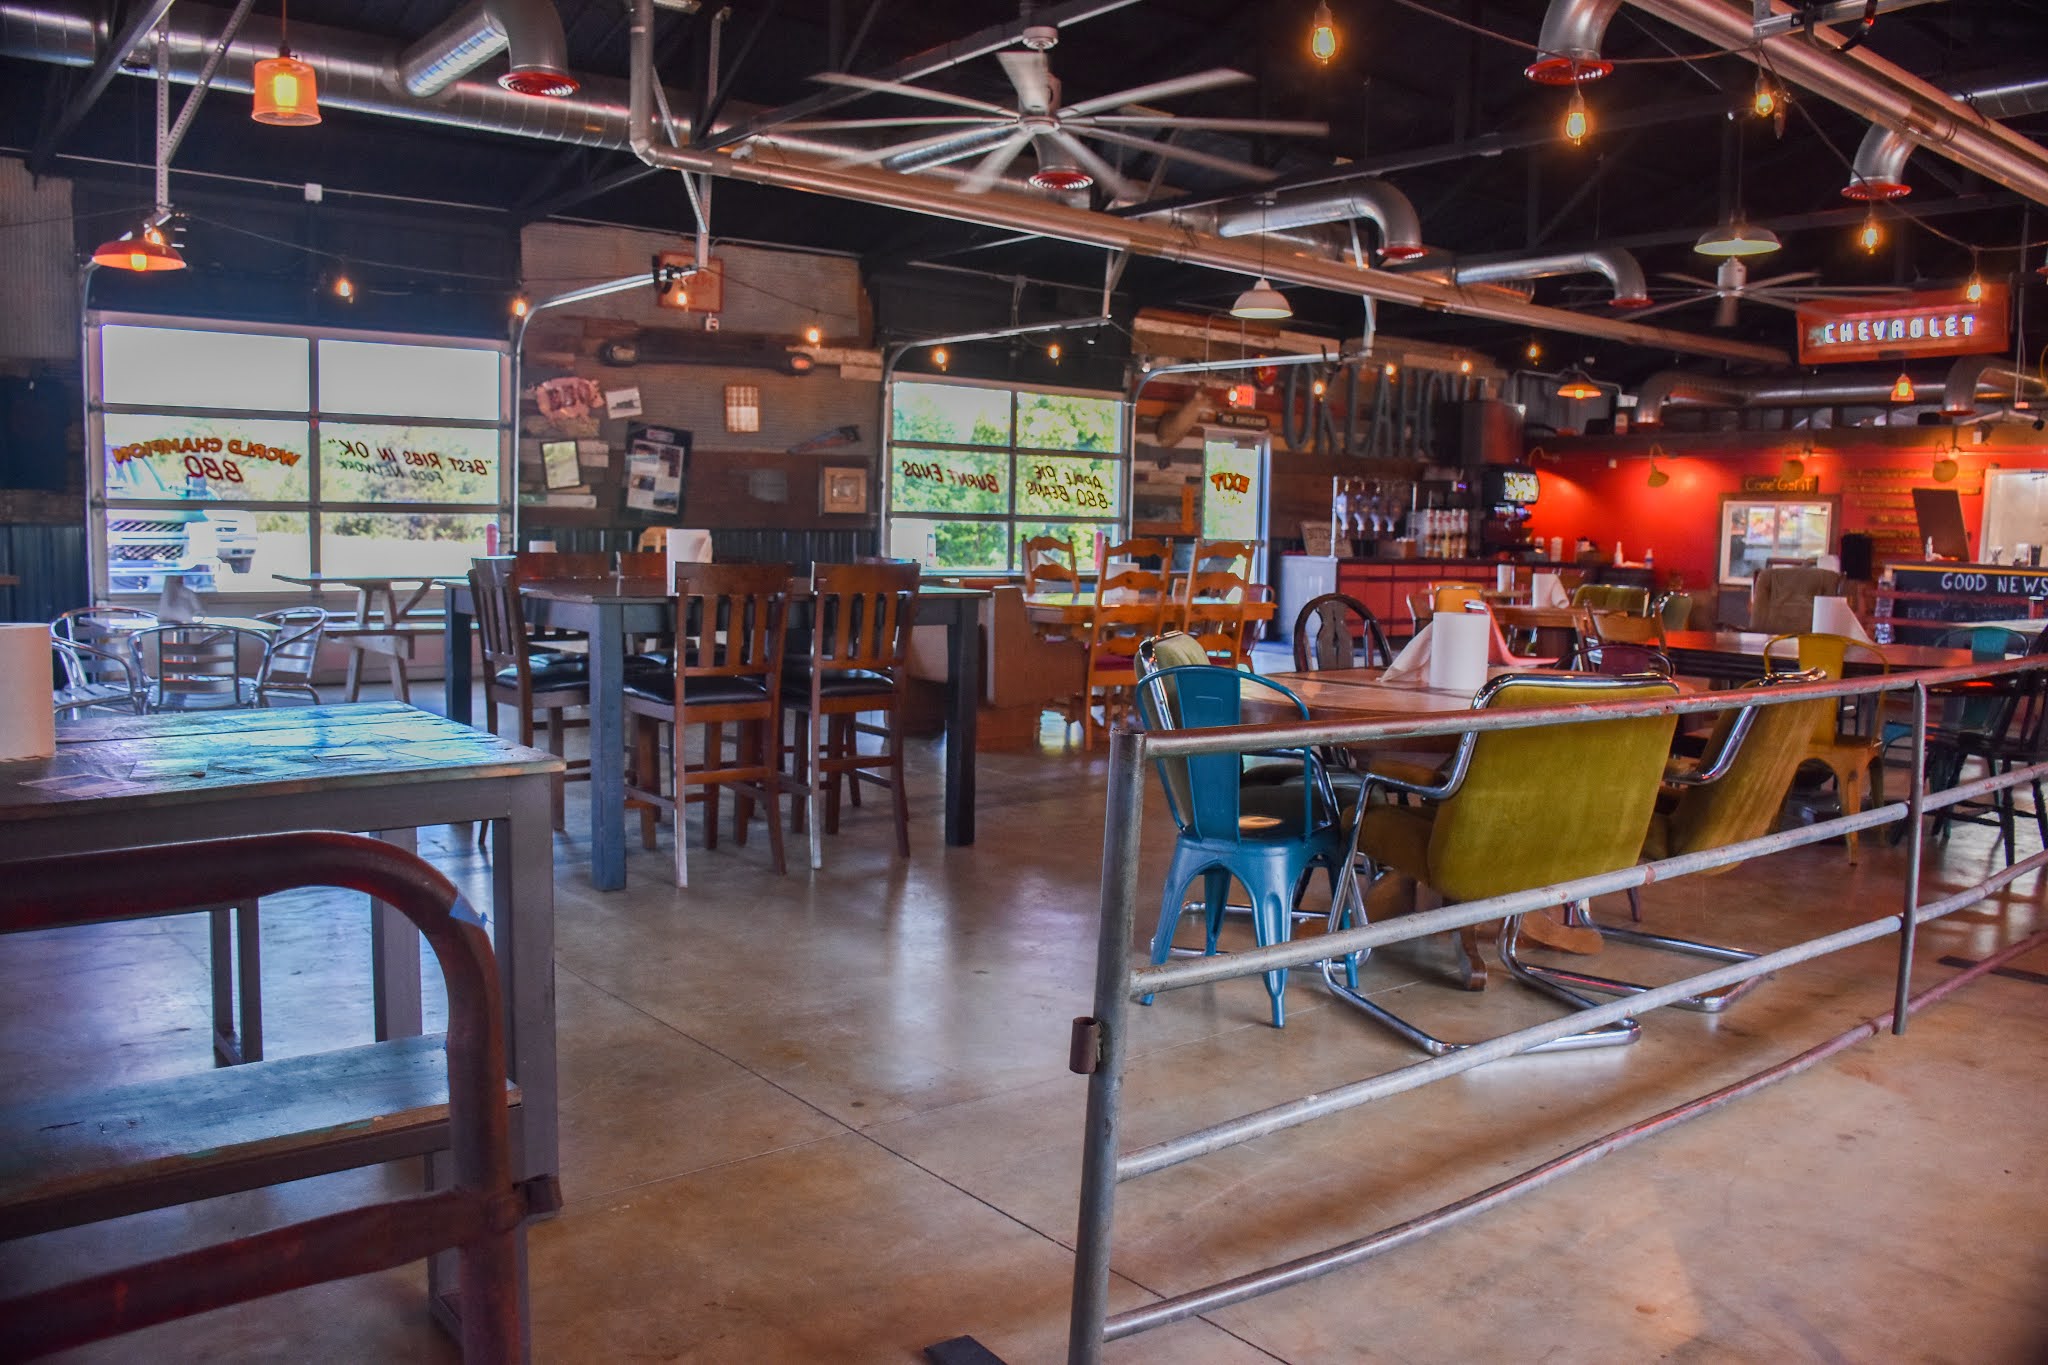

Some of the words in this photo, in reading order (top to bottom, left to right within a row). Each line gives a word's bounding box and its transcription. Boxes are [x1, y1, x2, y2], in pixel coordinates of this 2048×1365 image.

[1824, 315, 1975, 344] CHEVROLET
[1941, 572, 1987, 592] GOOD
[1997, 576, 2048, 597] NEWS
